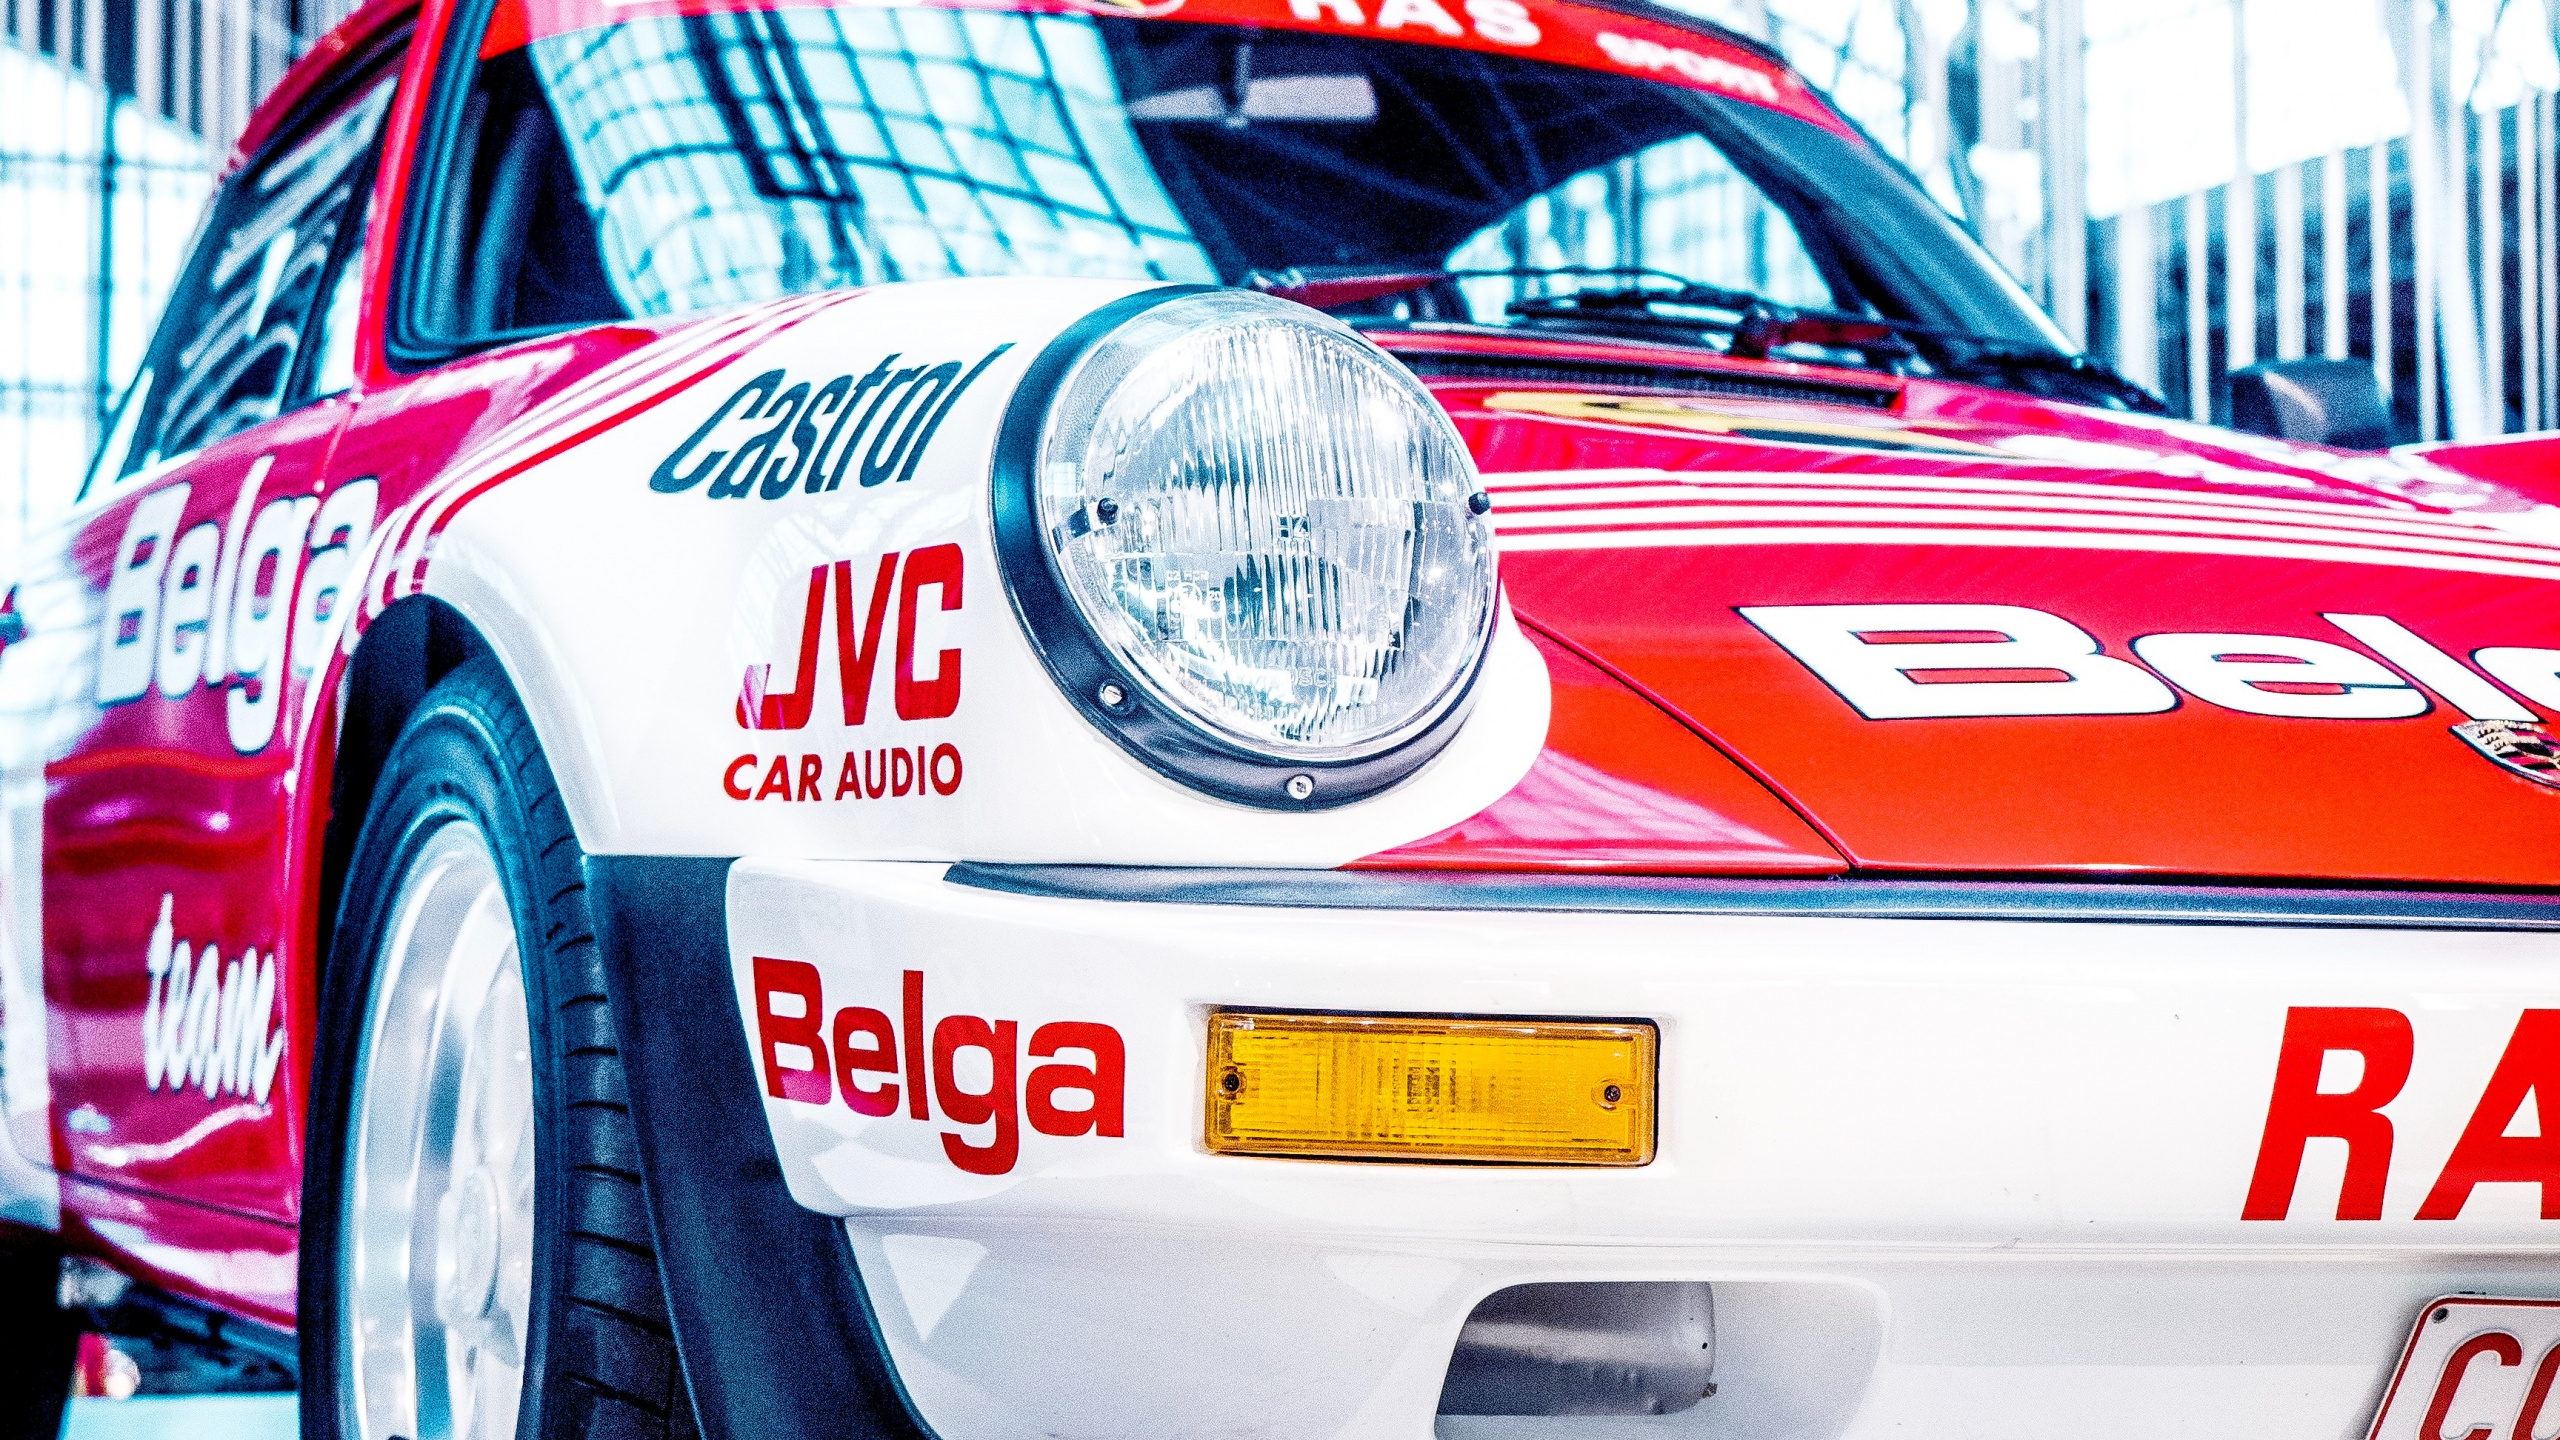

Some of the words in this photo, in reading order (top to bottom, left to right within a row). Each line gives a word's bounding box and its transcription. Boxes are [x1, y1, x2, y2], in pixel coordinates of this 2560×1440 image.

[649, 342, 1018, 500] Castrol
[98, 453, 380, 754] Belga
[735, 542, 964, 730] JVC
[723, 752, 823, 802] CAR
[835, 742, 964, 801] AUDIO
[145, 892, 284, 1106] team
[752, 956, 1126, 1176] Belga
[2240, 1005, 2560, 1221] RA
